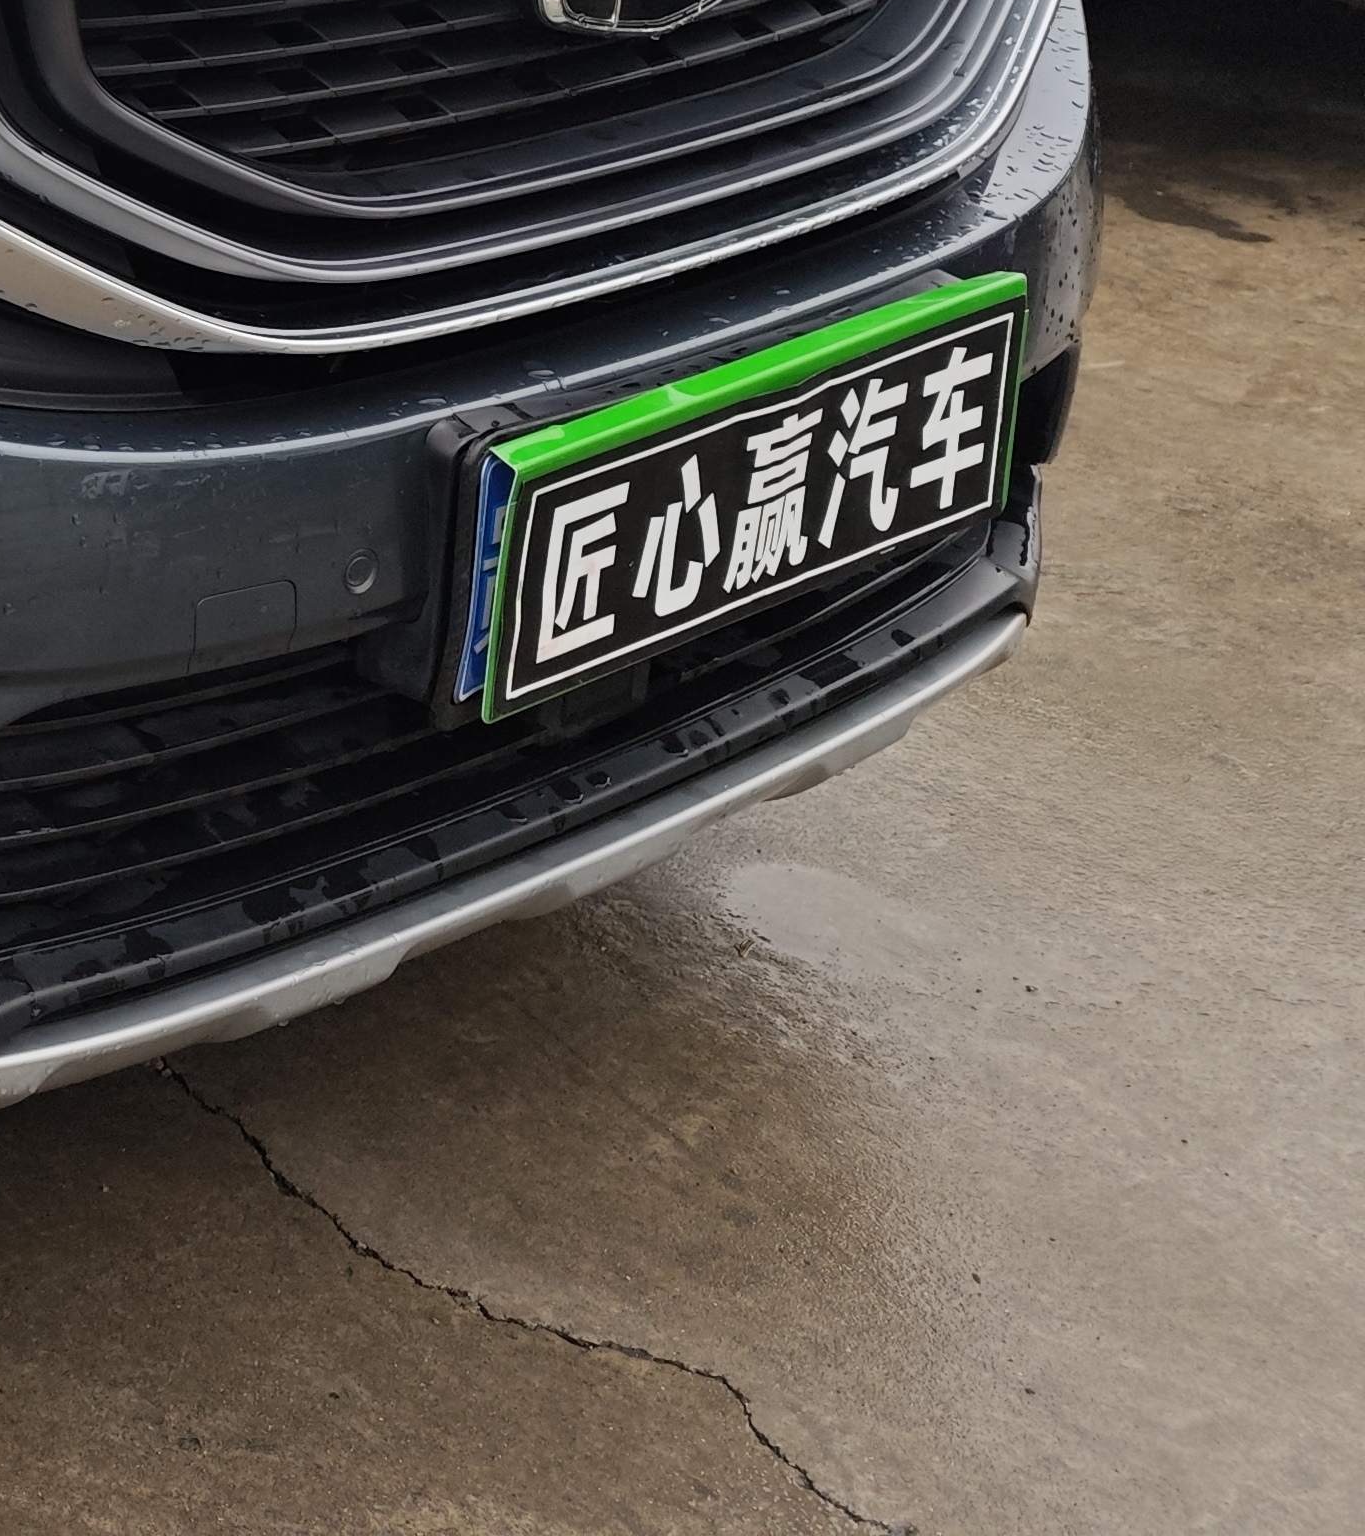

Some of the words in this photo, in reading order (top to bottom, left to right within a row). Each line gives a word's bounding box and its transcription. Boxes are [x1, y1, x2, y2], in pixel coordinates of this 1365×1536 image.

[535, 346, 993, 664] 匠心赢汽车
